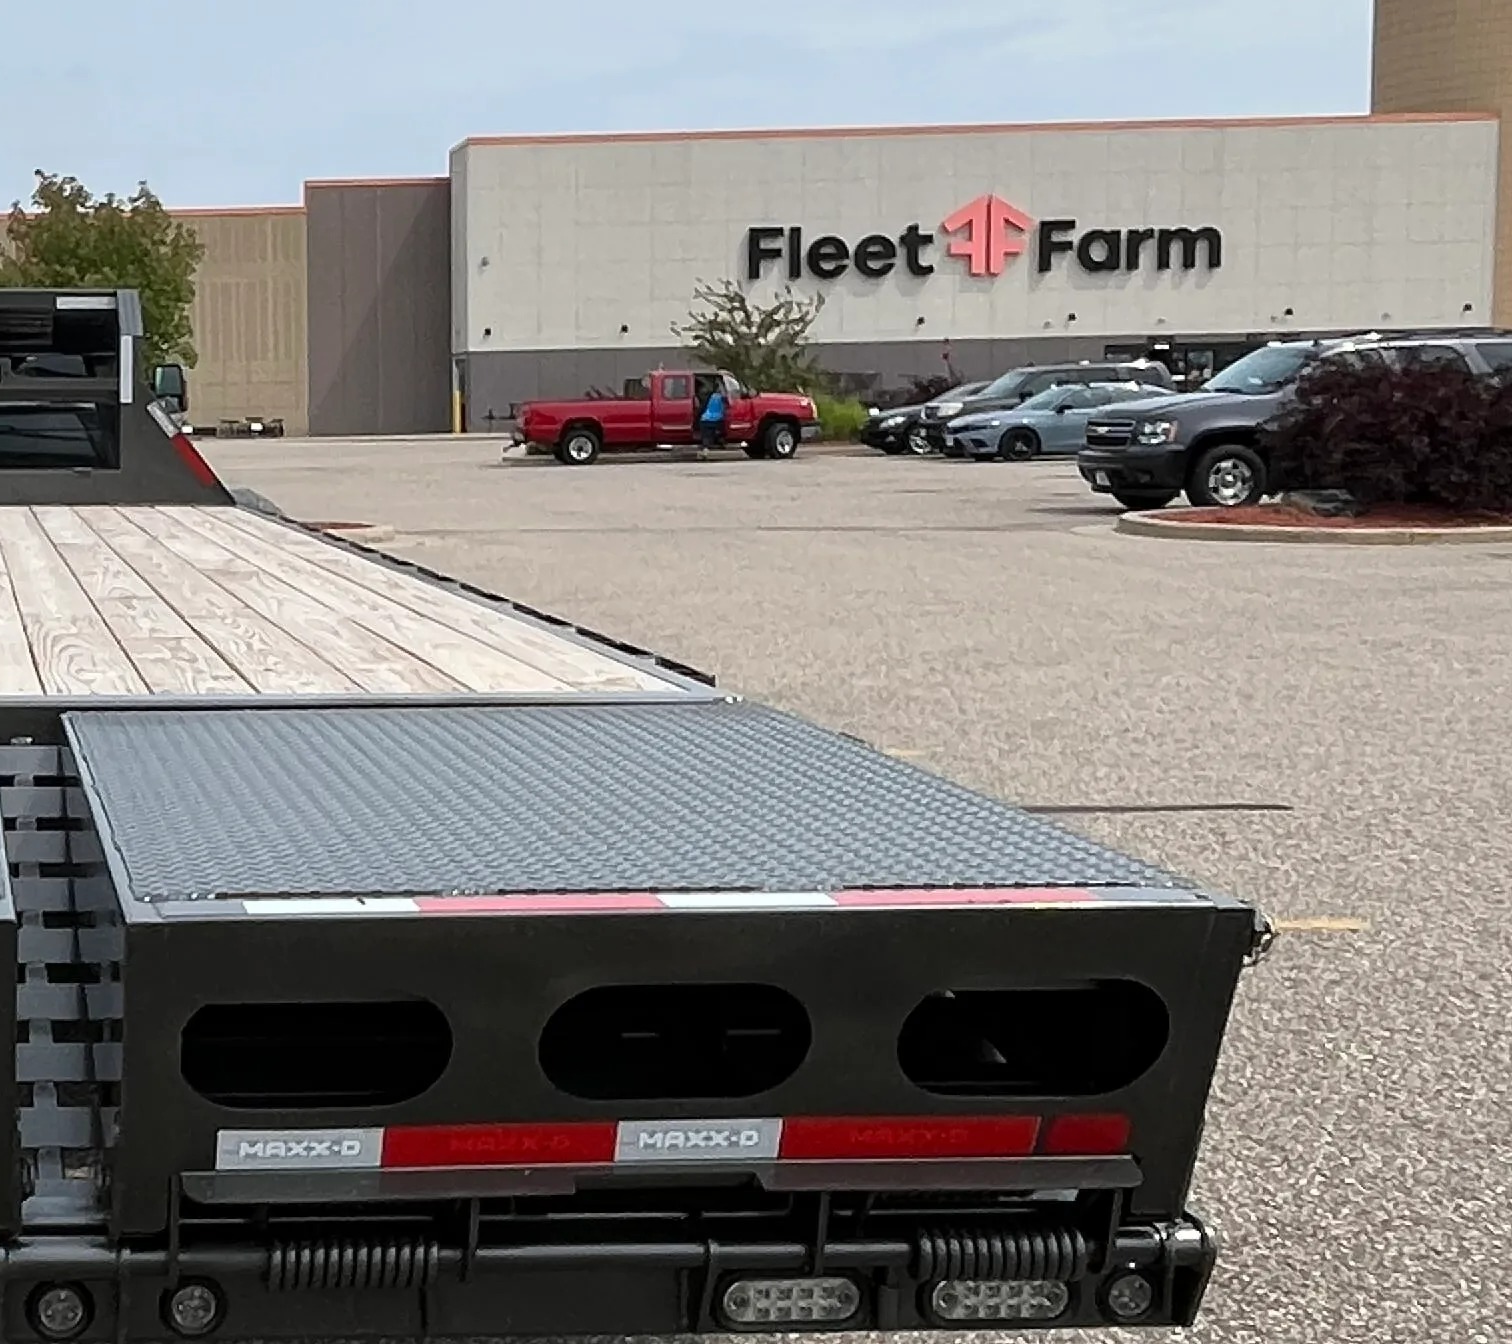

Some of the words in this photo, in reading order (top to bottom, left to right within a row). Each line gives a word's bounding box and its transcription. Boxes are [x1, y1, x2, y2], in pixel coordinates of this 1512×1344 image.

[748, 223, 935, 280] Fleet
[1038, 218, 1222, 273] Farm
[239, 1140, 361, 1158] MAXX-D
[639, 1130, 760, 1149] MAXX-D
